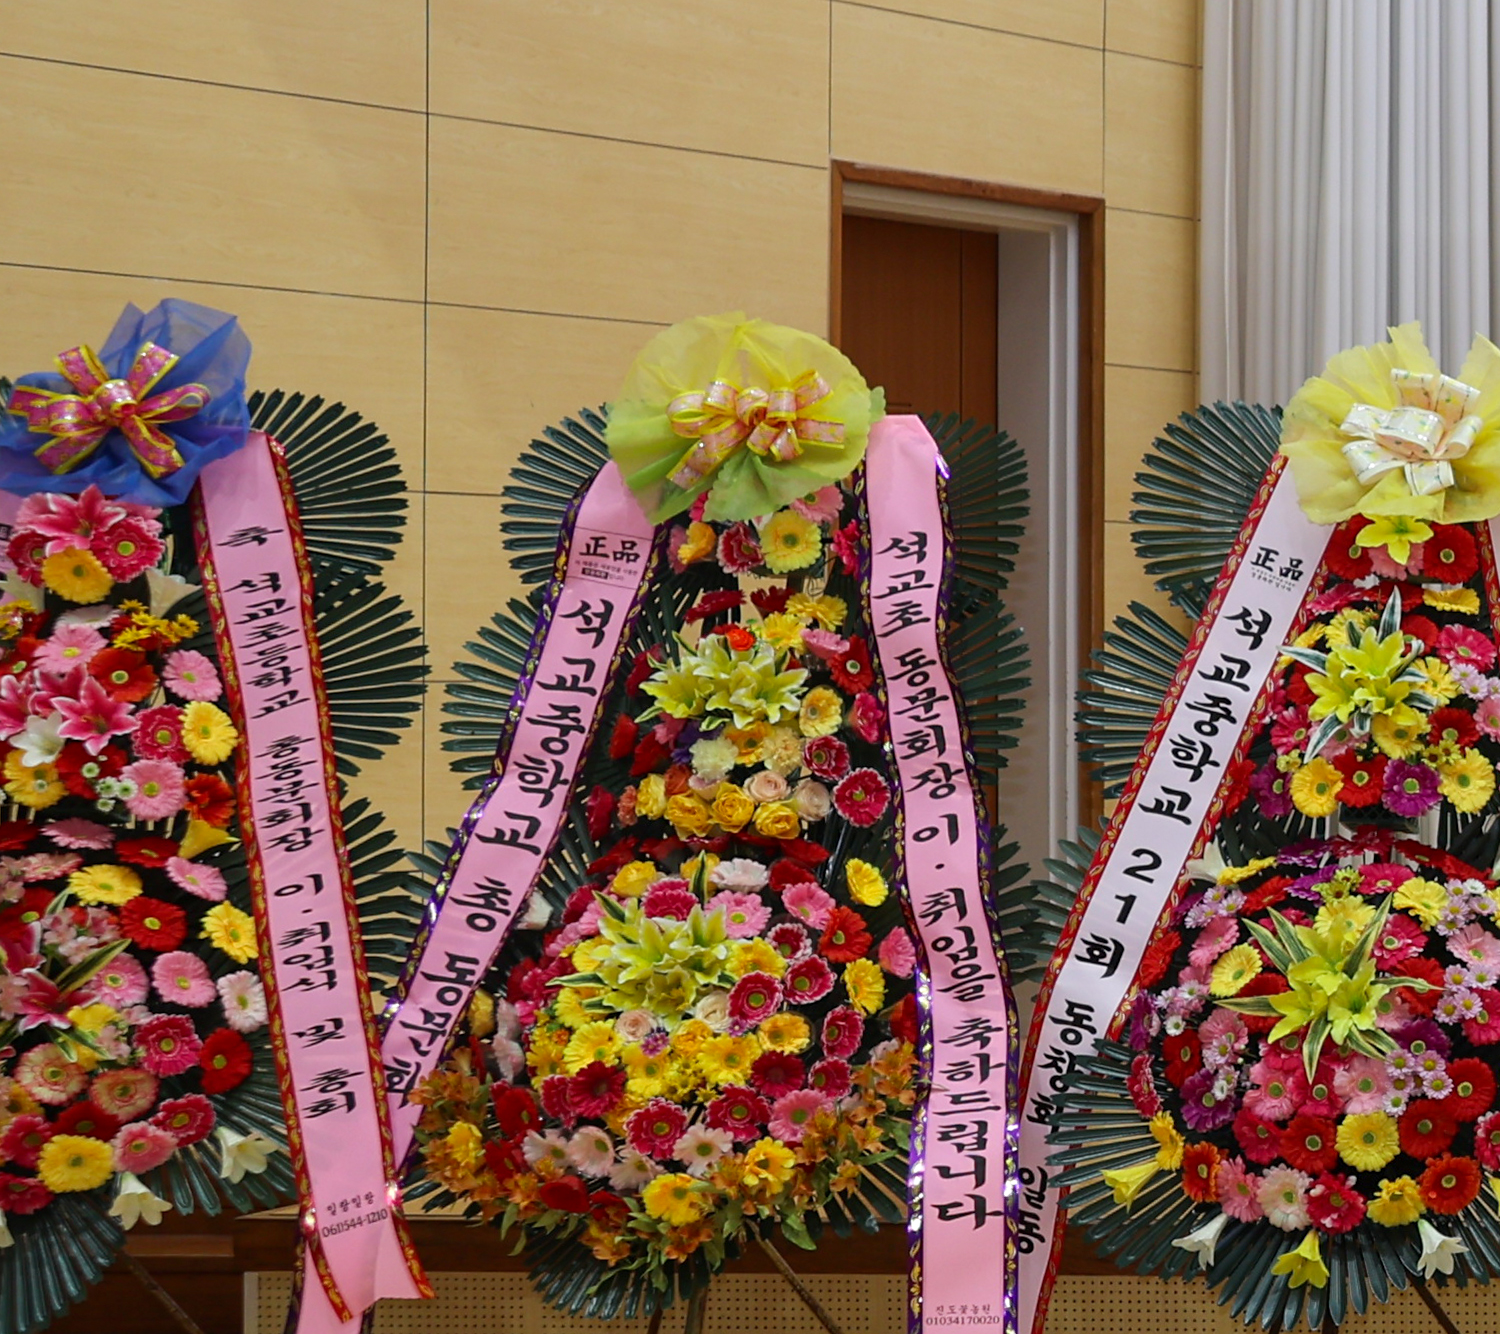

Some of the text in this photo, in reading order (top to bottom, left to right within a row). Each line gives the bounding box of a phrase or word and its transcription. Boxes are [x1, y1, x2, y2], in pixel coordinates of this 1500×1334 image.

[578, 536, 641, 564] 正品
[872, 531, 934, 638] 석교초
[1250, 546, 1304, 582] 正品
[224, 572, 310, 719] 석교초등학교
[474, 599, 614, 856] 석교중학교
[887, 648, 964, 800] 동문회장
[1138, 606, 1272, 825] 석교중학교
[254, 735, 325, 853] 총동문회장
[1075, 848, 1162, 978] 21회
[291, 1017, 346, 1048] 및
[300, 1067, 364, 1119] 총회
[931, 1017, 1006, 1230] 축하드립니다
[1018, 1166, 1048, 1254] 일동
[925, 1315, 1000, 1326] 01034170020
